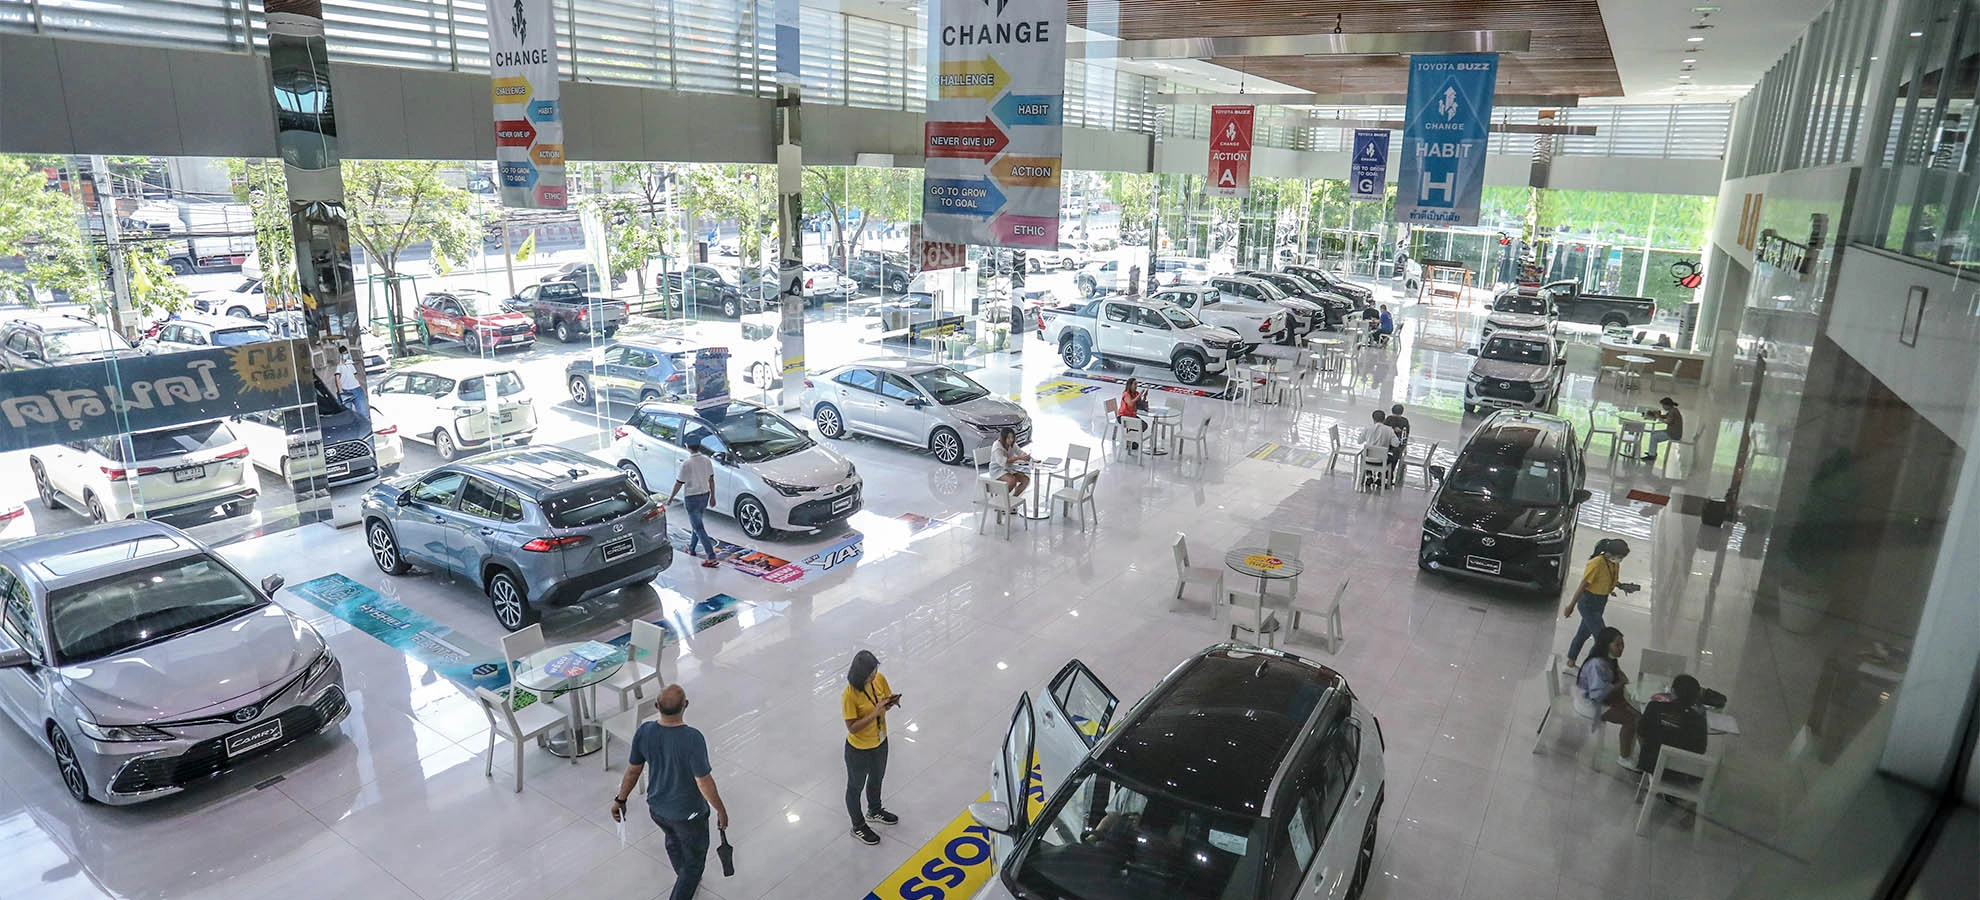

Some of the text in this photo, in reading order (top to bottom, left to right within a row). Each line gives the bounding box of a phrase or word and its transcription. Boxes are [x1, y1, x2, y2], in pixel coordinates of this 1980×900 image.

[942, 21, 1049, 45] CHANGE
[496, 49, 548, 67] CHANGE
[1418, 63, 1490, 71] TOYOTA BUZZ
[932, 74, 994, 86] CHALLENGE
[495, 86, 526, 96] CHALLENGE
[538, 107, 553, 115] HABIT
[1018, 105, 1049, 115] HABIT
[498, 130, 530, 138] NEVER GIVE UP
[931, 136, 995, 147] NEVER GIVE UP
[539, 150, 560, 159] ACTION
[1416, 143, 1472, 158] HABIT
[1213, 152, 1248, 161] ACTION
[1011, 166, 1051, 177] ACTION
[1218, 168, 1235, 185] A
[931, 186, 987, 197] GO TO GROW
[1360, 179, 1373, 193] G
[1421, 171, 1455, 202] H
[544, 192, 561, 201] ETHIC
[941, 197, 977, 208] TO GOAL
[1014, 225, 1045, 236] ETHIC
[231, 726, 279, 749] CAMRY
